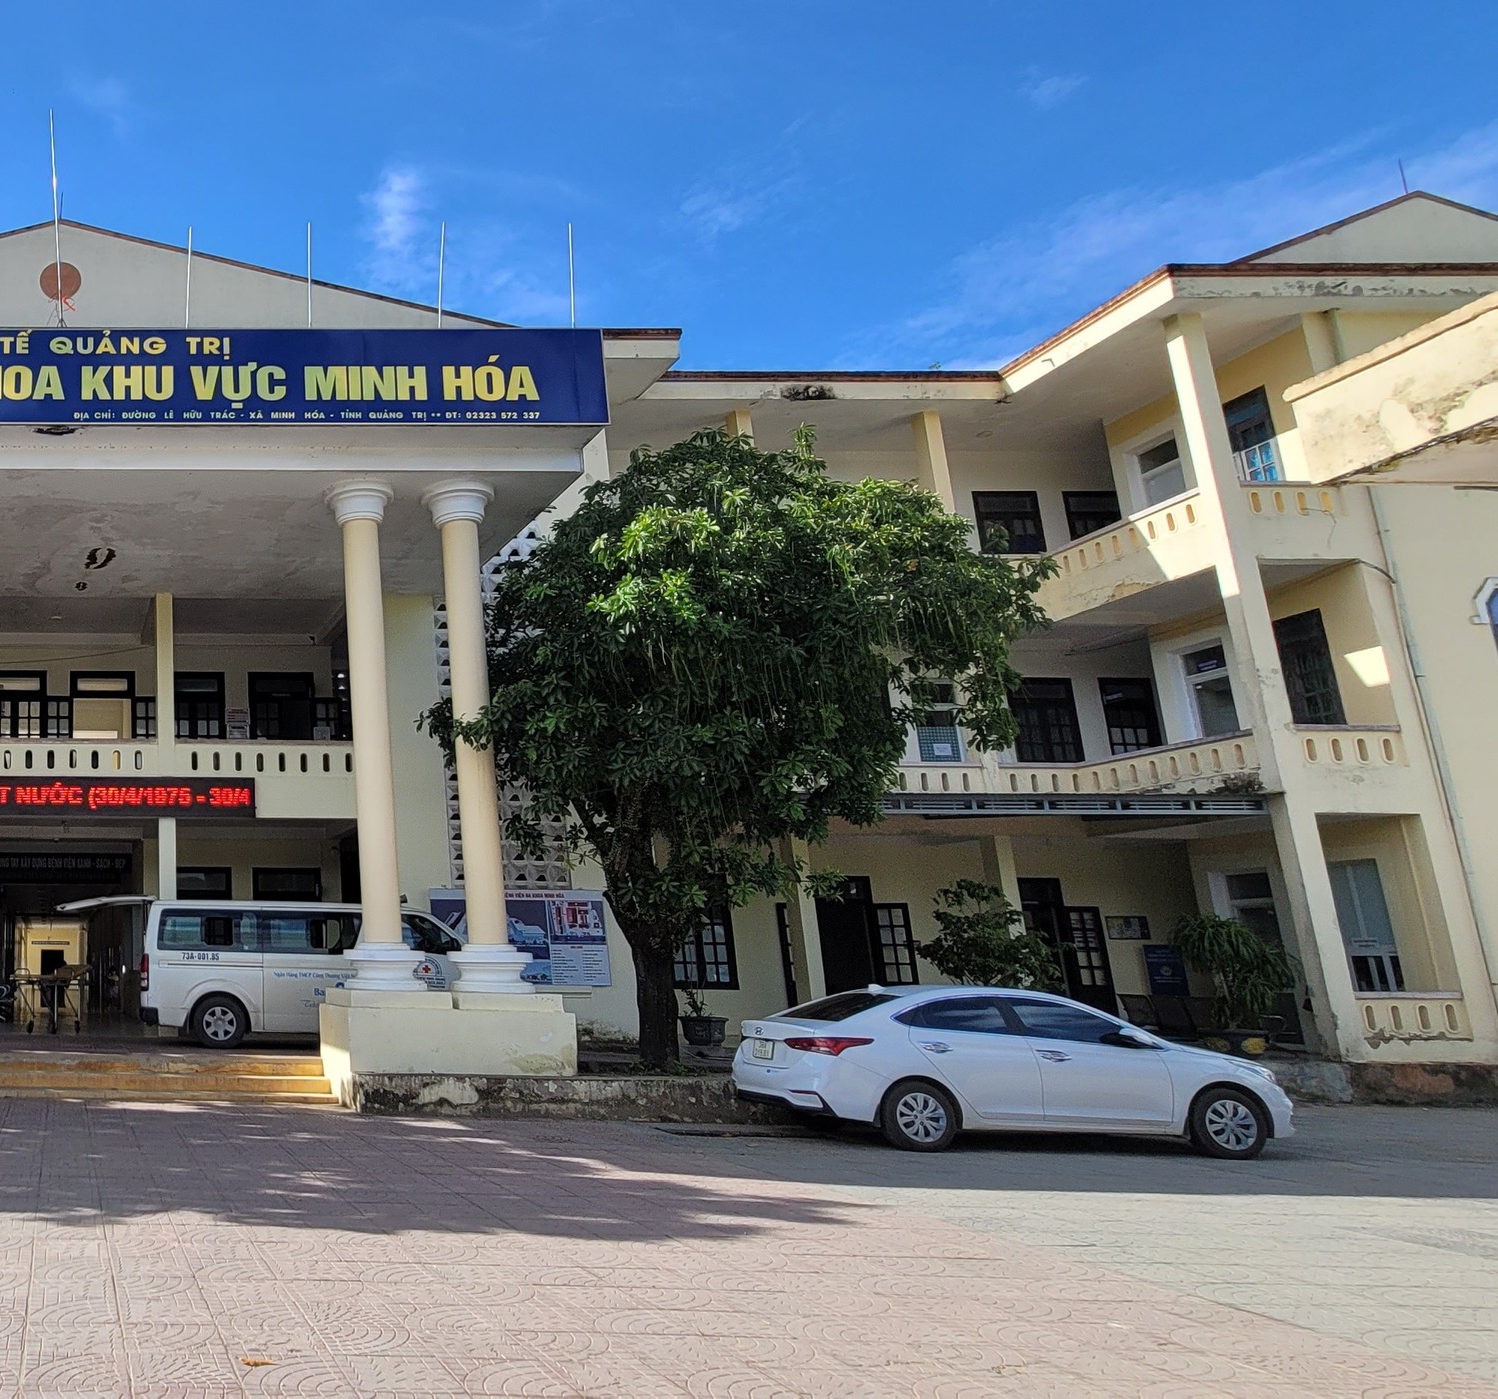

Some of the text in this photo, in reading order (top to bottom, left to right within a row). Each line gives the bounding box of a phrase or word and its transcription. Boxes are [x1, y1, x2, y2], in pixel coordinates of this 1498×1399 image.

[0, 329, 32, 354] TẾ
[49, 330, 167, 355] QUẢNG
[185, 336, 230, 360] TRỊ
[81, 365, 174, 401] KHU
[189, 361, 287, 409] VỰC
[304, 365, 428, 401] MINH
[441, 354, 540, 402] HÓA
[73, 411, 90, 422] ĐỊA
[121, 409, 157, 419] ĐƯỜNG
[183, 409, 202, 419] HỮU
[210, 409, 236, 419] TRÁC
[249, 410, 263, 419] XÃ
[270, 411, 296, 419] MINH
[304, 409, 326, 419] HÓA
[340, 409, 362, 419] TỈNH
[368, 409, 404, 419] QUẢNG
[411, 411, 427, 422] TRỊ
[465, 411, 497, 420] 02323
[500, 411, 518, 420] 572
[522, 411, 540, 420] 337
[15, 781, 83, 806] NƯỚC
